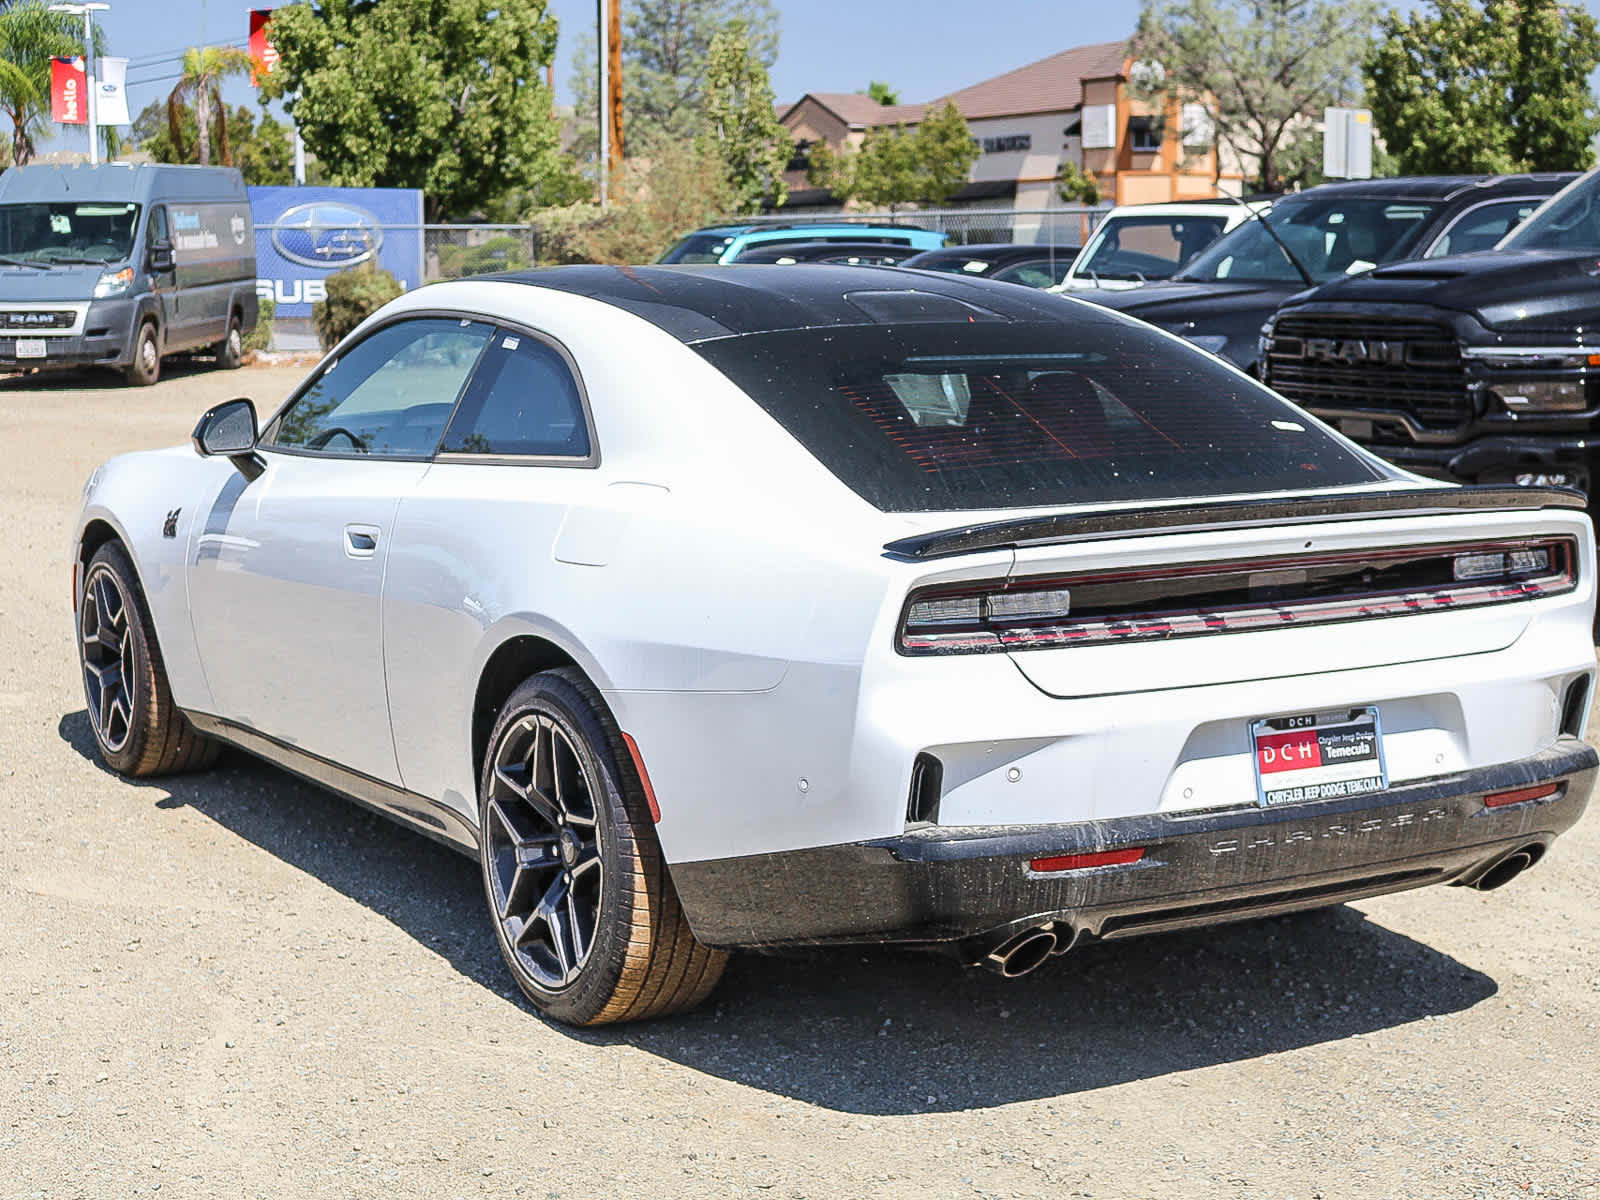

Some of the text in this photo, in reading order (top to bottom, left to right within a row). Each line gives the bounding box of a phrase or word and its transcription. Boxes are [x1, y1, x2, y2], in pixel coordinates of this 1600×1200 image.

[62, 79, 78, 121] hello
[10, 313, 54, 323] RAM
[1306, 338, 1404, 361] RAM
[1289, 716, 1313, 728] DCH
[1318, 730, 1375, 746] Chrysler Jeep Dodge
[1263, 741, 1313, 764] DCH
[1325, 741, 1371, 760] Temecula
[1267, 777, 1383, 805] CHRYSLER JEEP DODGE TEMECULA
[1209, 808, 1446, 856] CHARGER
